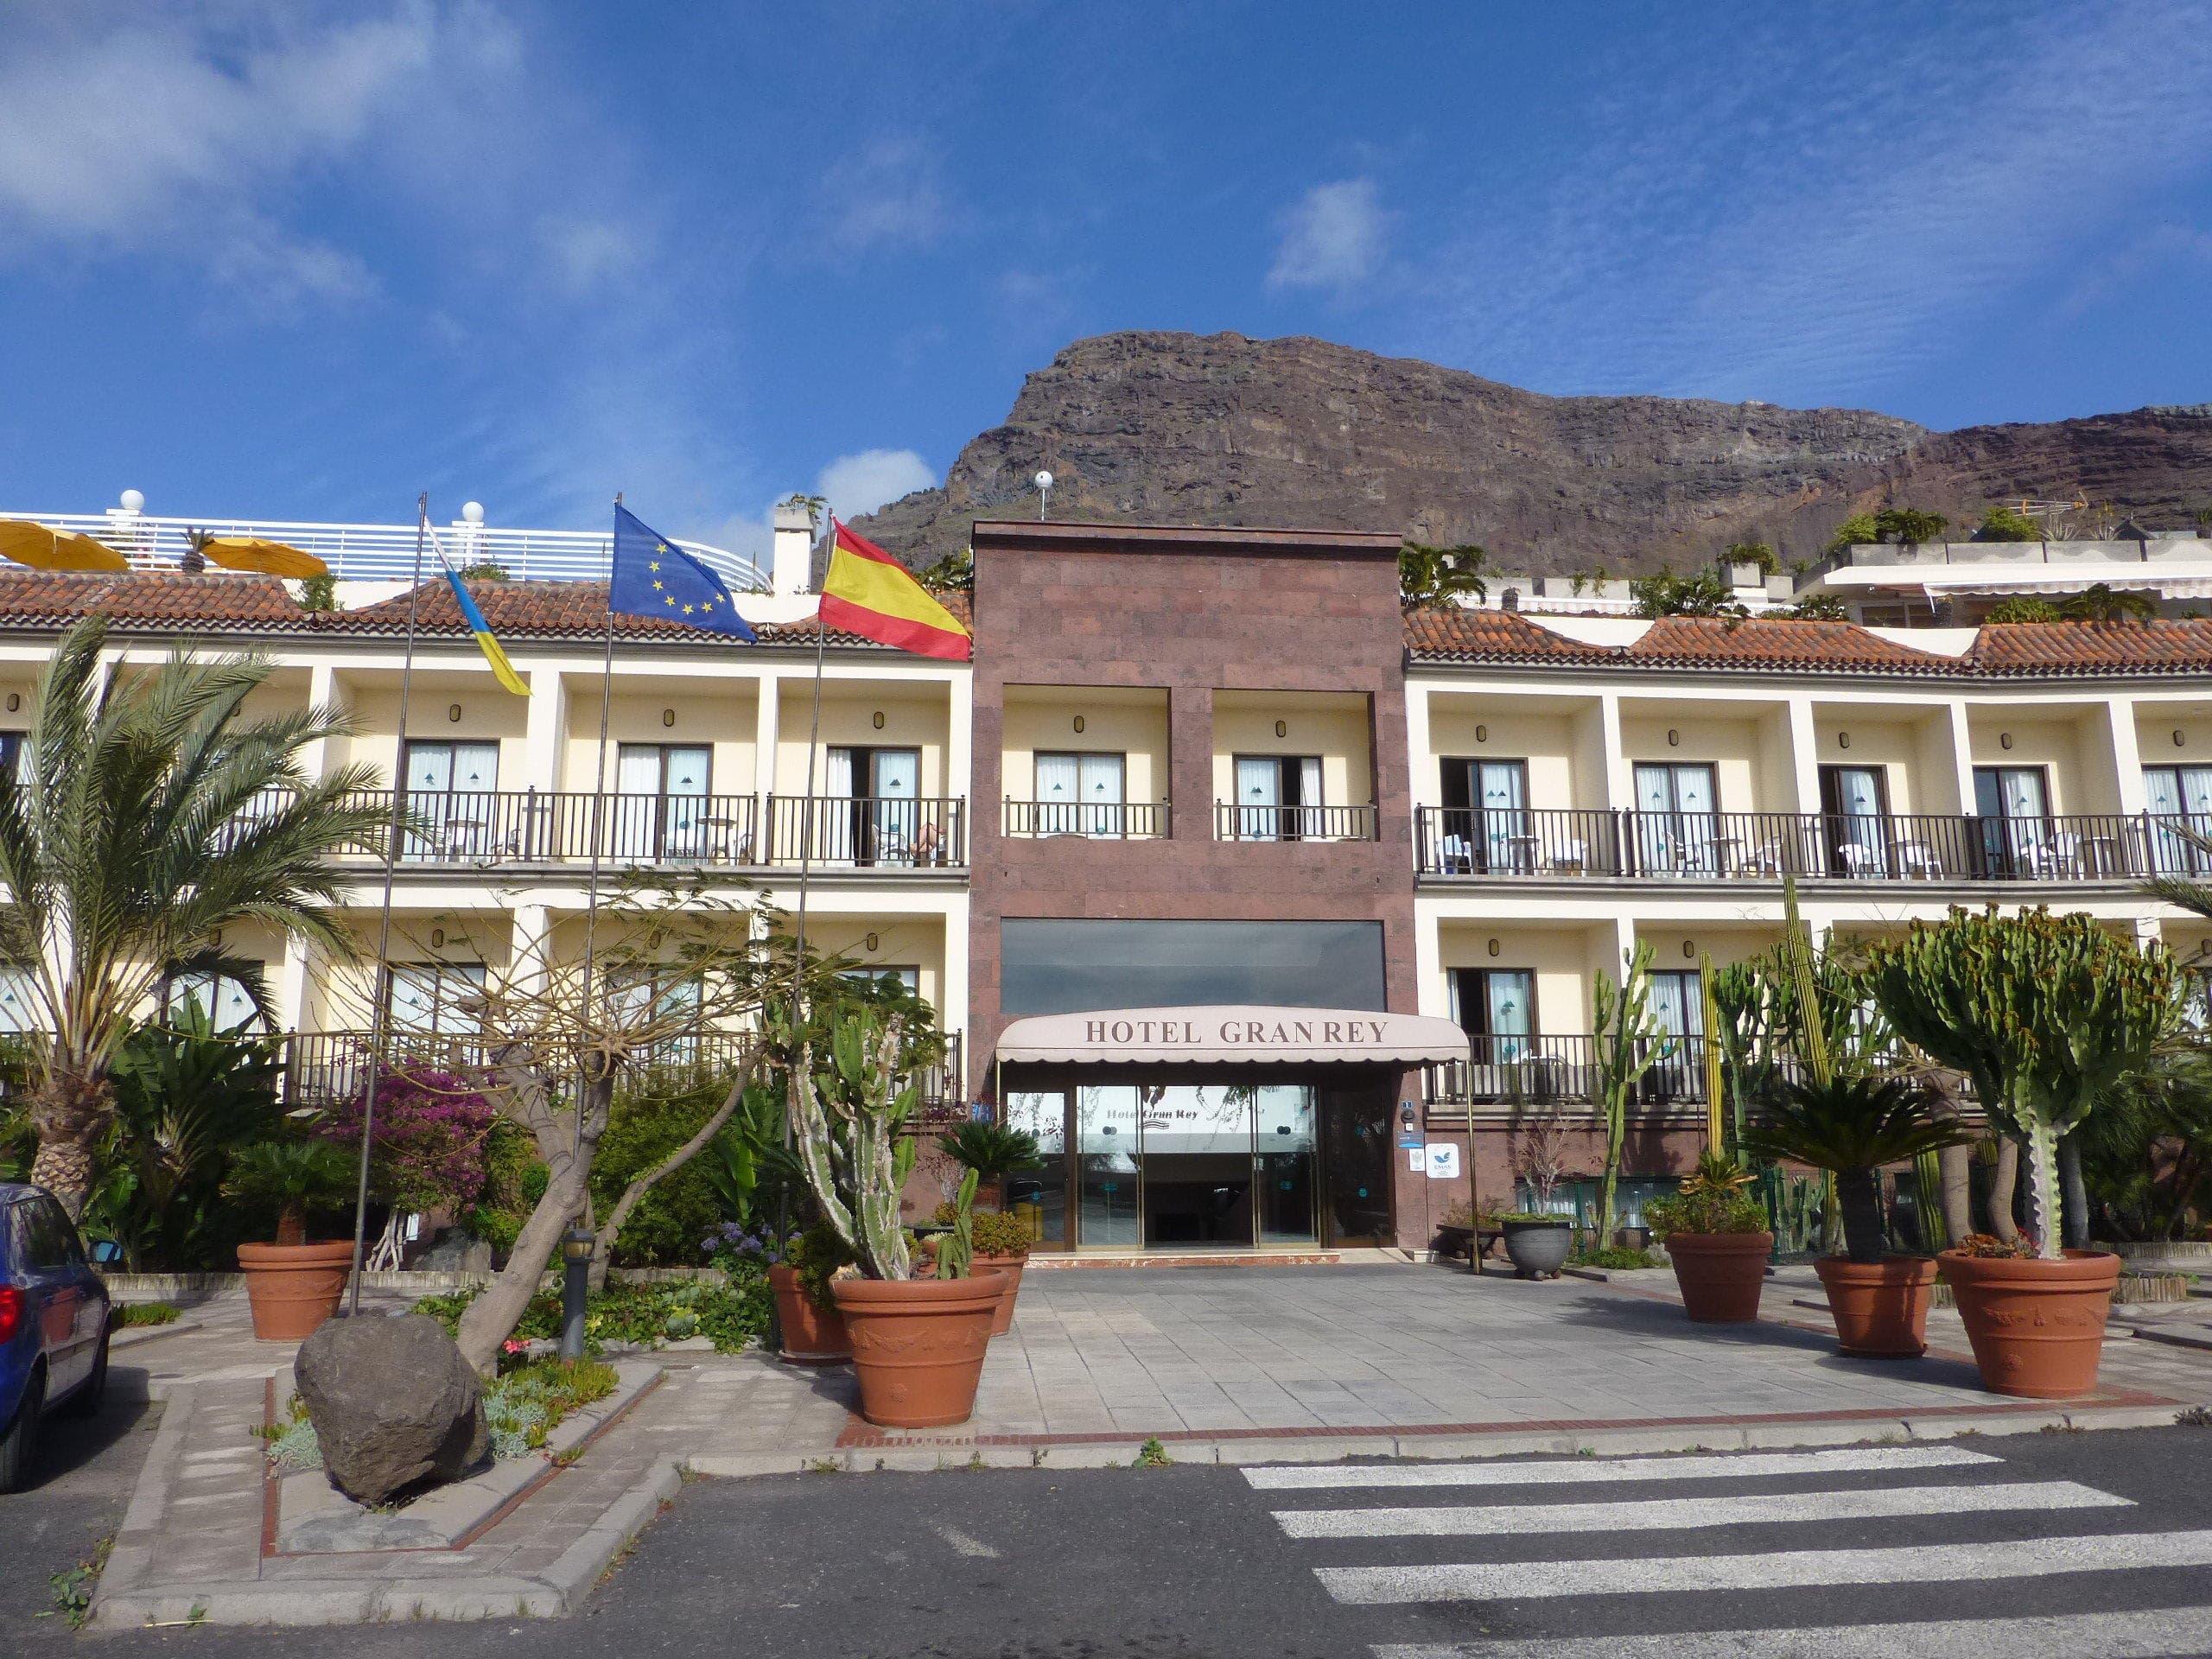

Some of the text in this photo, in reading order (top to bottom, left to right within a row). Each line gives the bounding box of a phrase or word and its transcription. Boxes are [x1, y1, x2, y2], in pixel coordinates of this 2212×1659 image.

[1085, 1020, 1389, 1043] HOTEL GRAN REY
[1143, 1109, 1173, 1119] Gran
[1176, 1109, 1198, 1121] Rey
